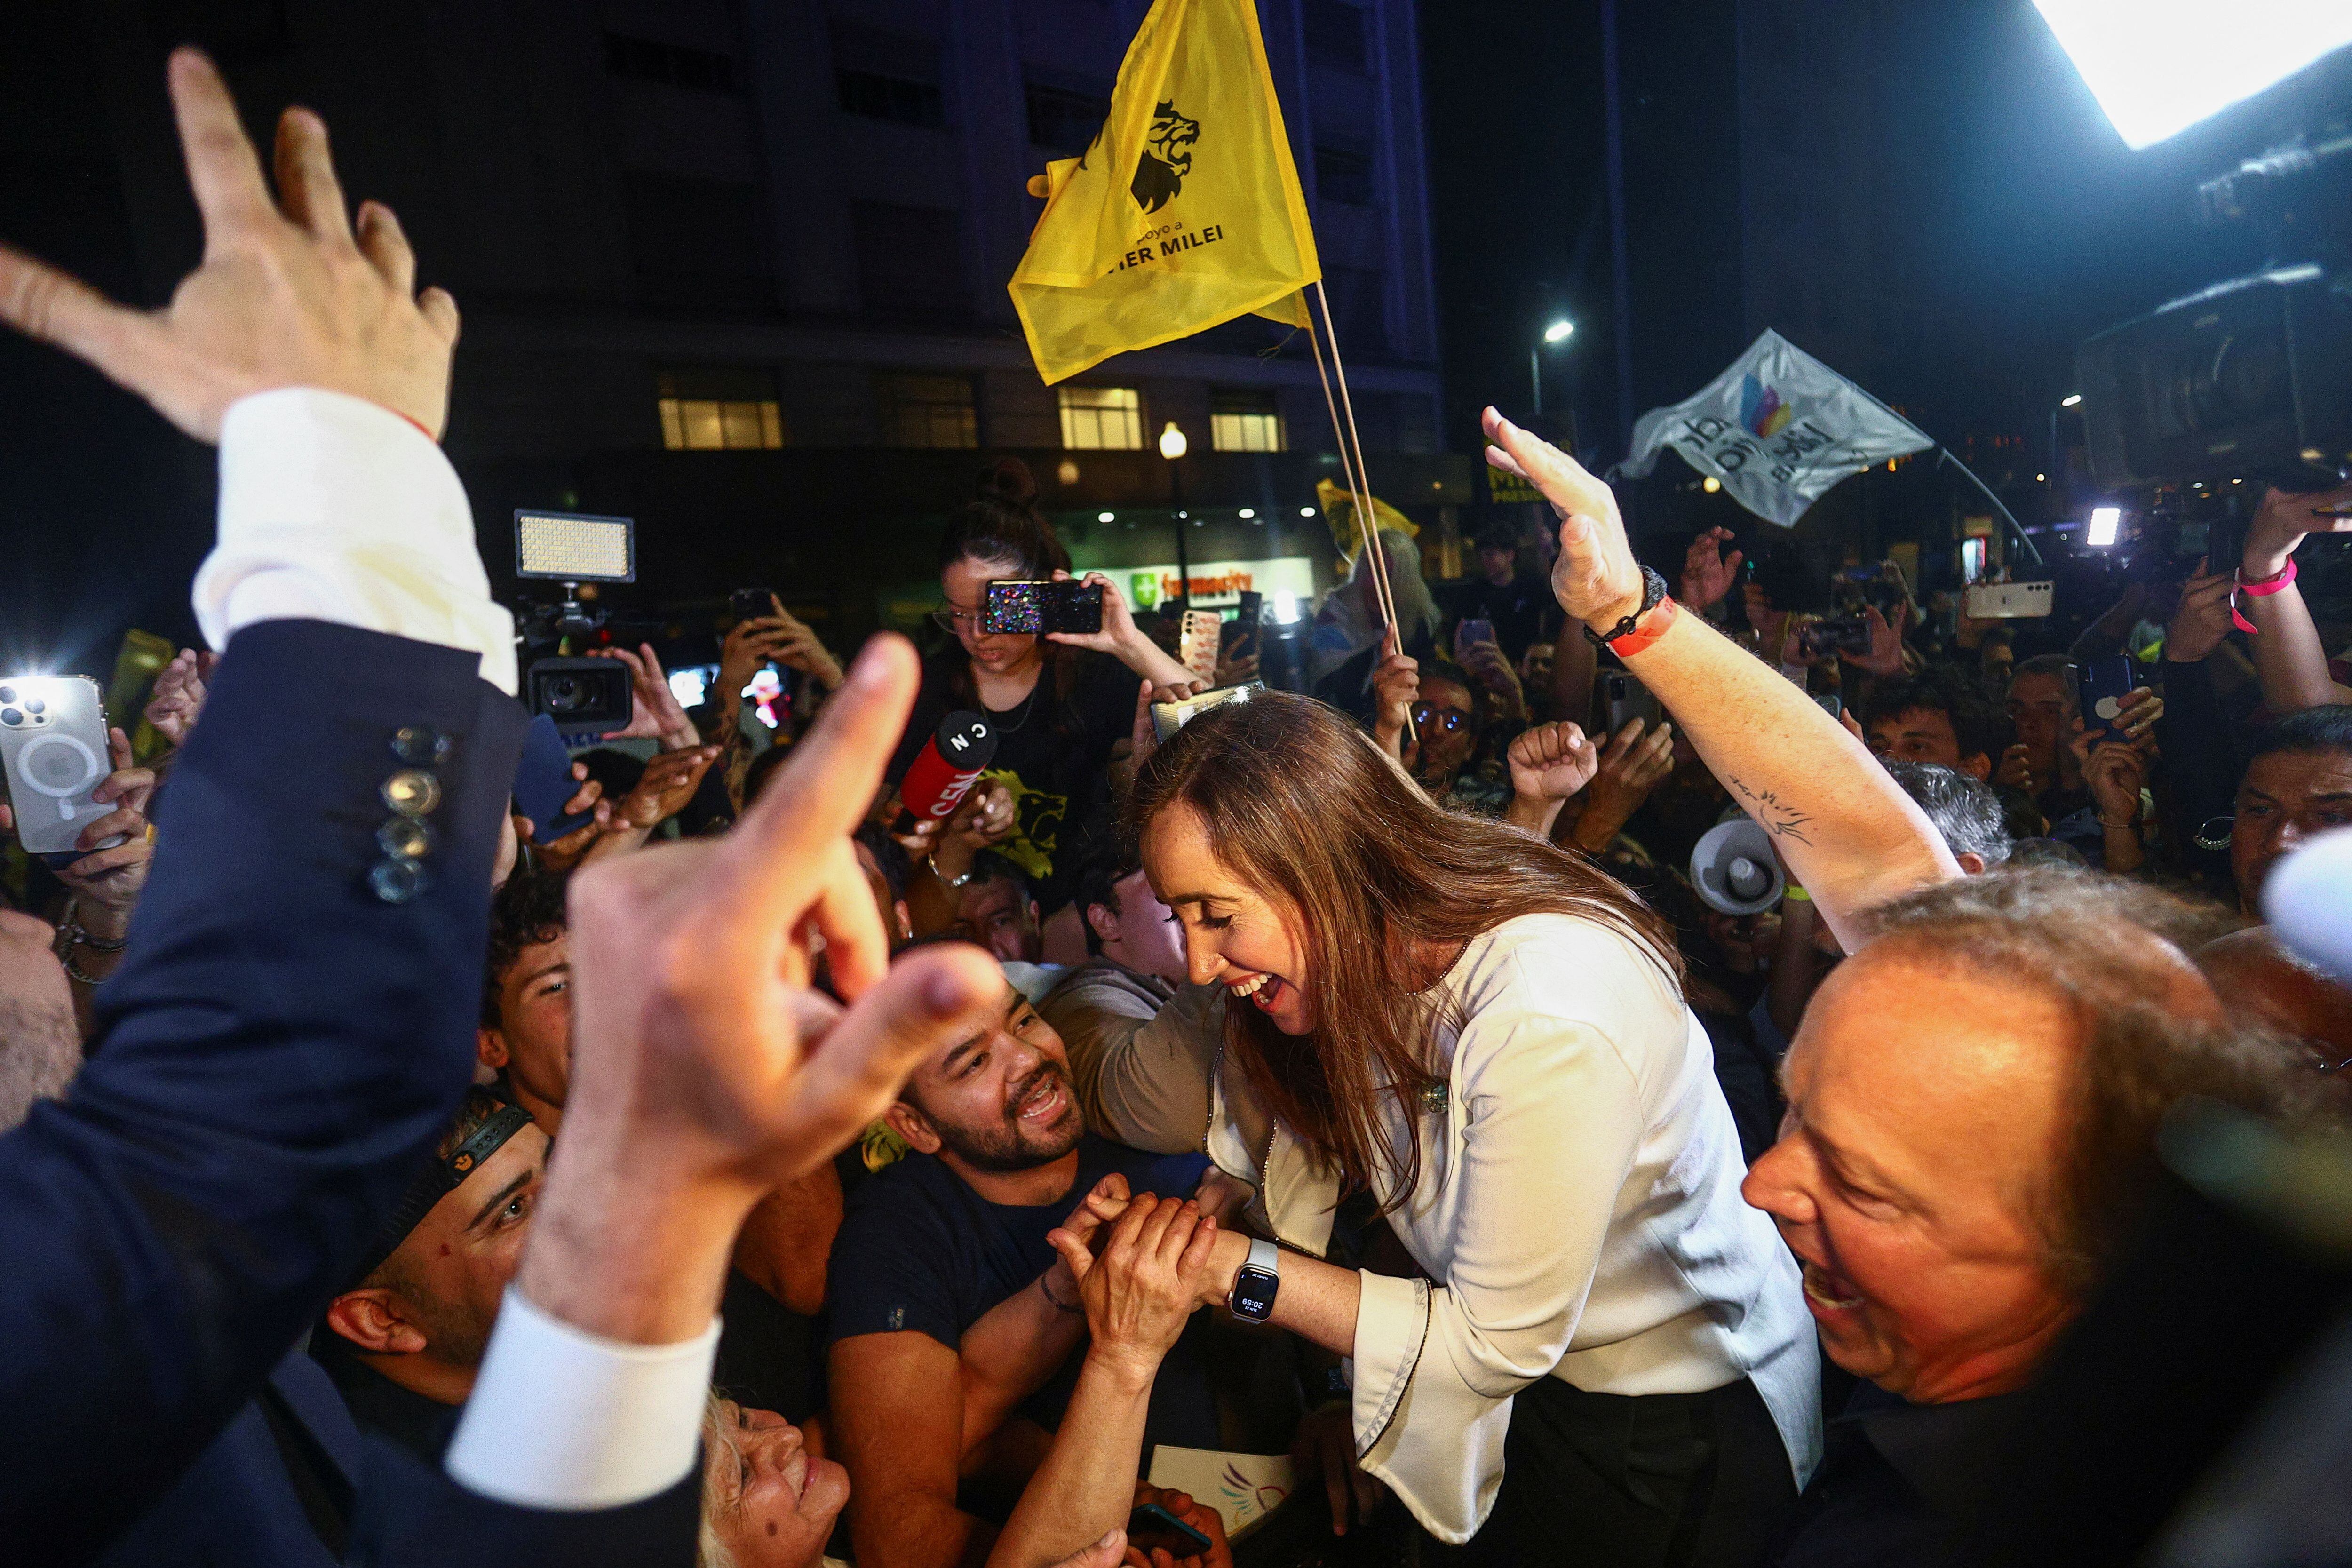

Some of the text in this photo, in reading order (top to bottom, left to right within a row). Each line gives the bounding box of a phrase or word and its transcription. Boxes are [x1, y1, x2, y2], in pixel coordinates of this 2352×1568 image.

[1174, 221, 1183, 230] a
[1108, 224, 1224, 274] IER MILEI
[1242, 1298, 1263, 1309] 20:59
